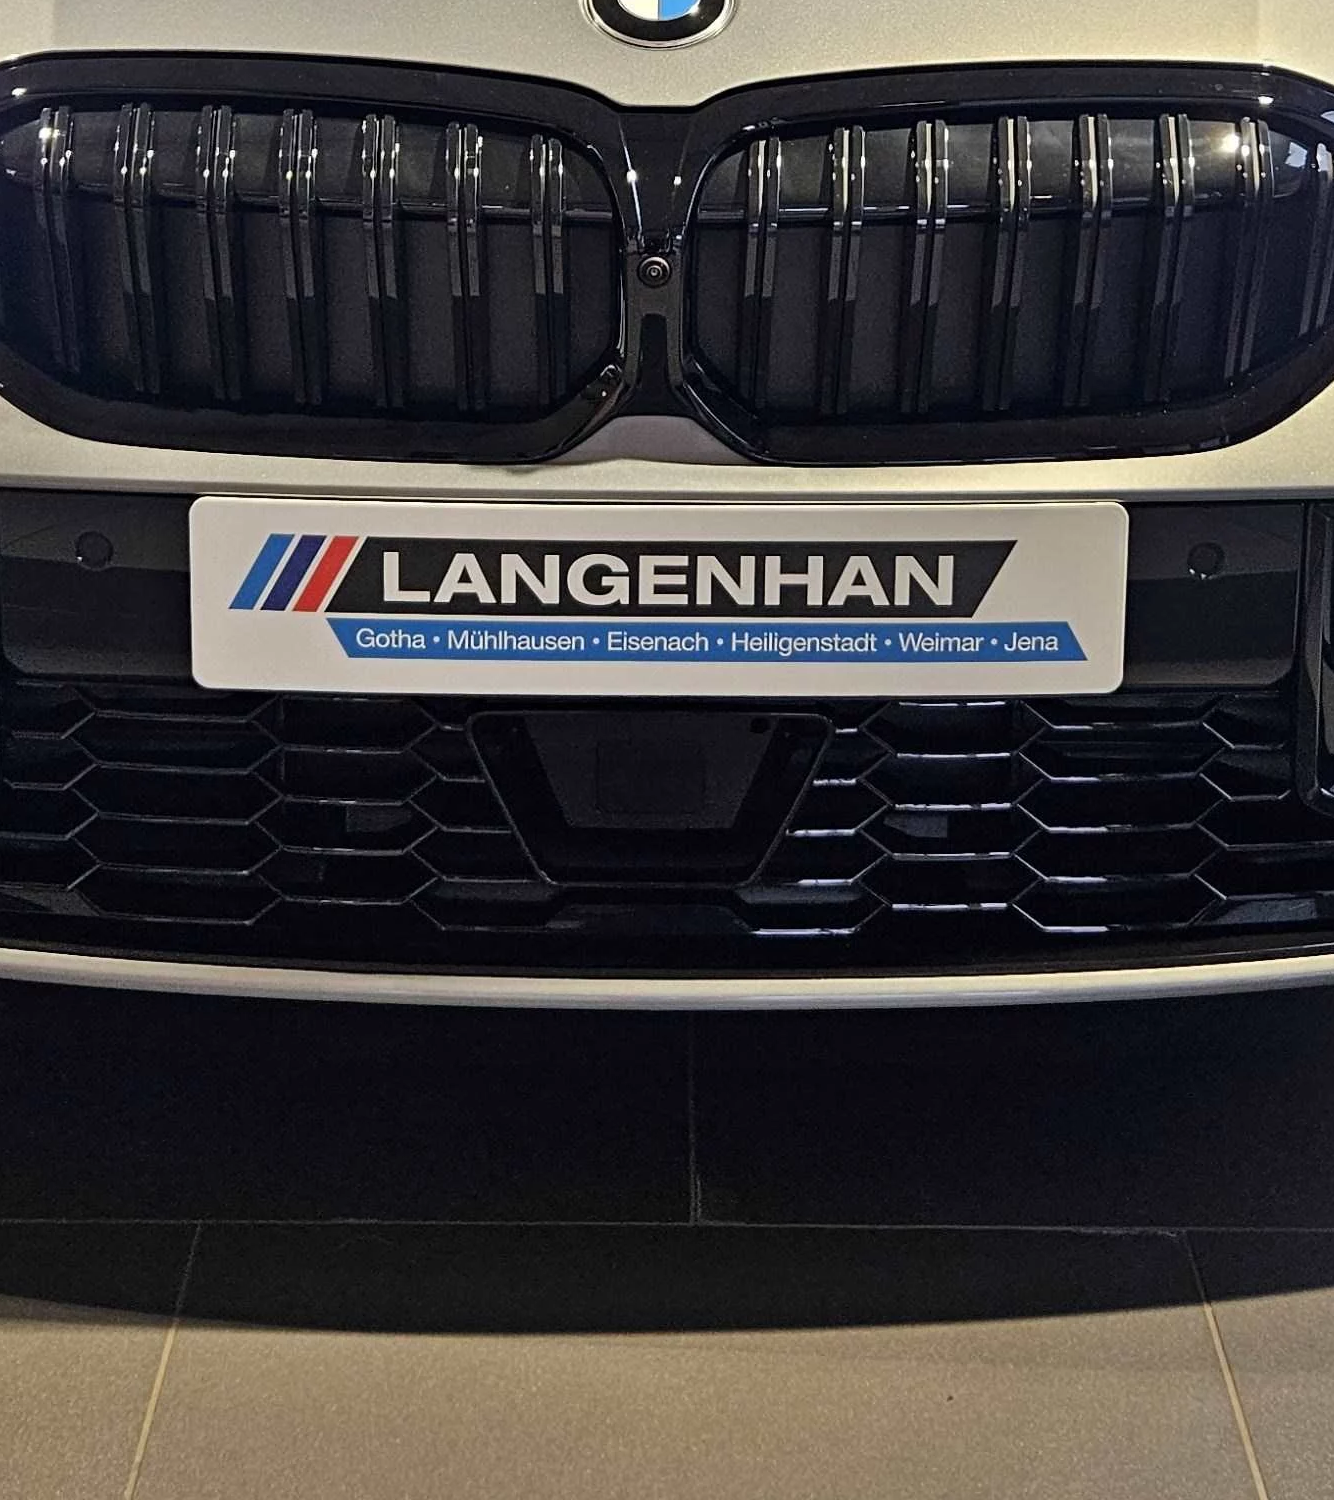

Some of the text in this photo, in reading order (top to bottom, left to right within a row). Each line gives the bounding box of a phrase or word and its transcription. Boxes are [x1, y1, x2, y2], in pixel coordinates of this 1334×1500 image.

[383, 551, 955, 606] LANGENHAN
[356, 627, 1059, 657] Gotha Mühlhausen Eisenach Heiligenstadt Weimar Jena
